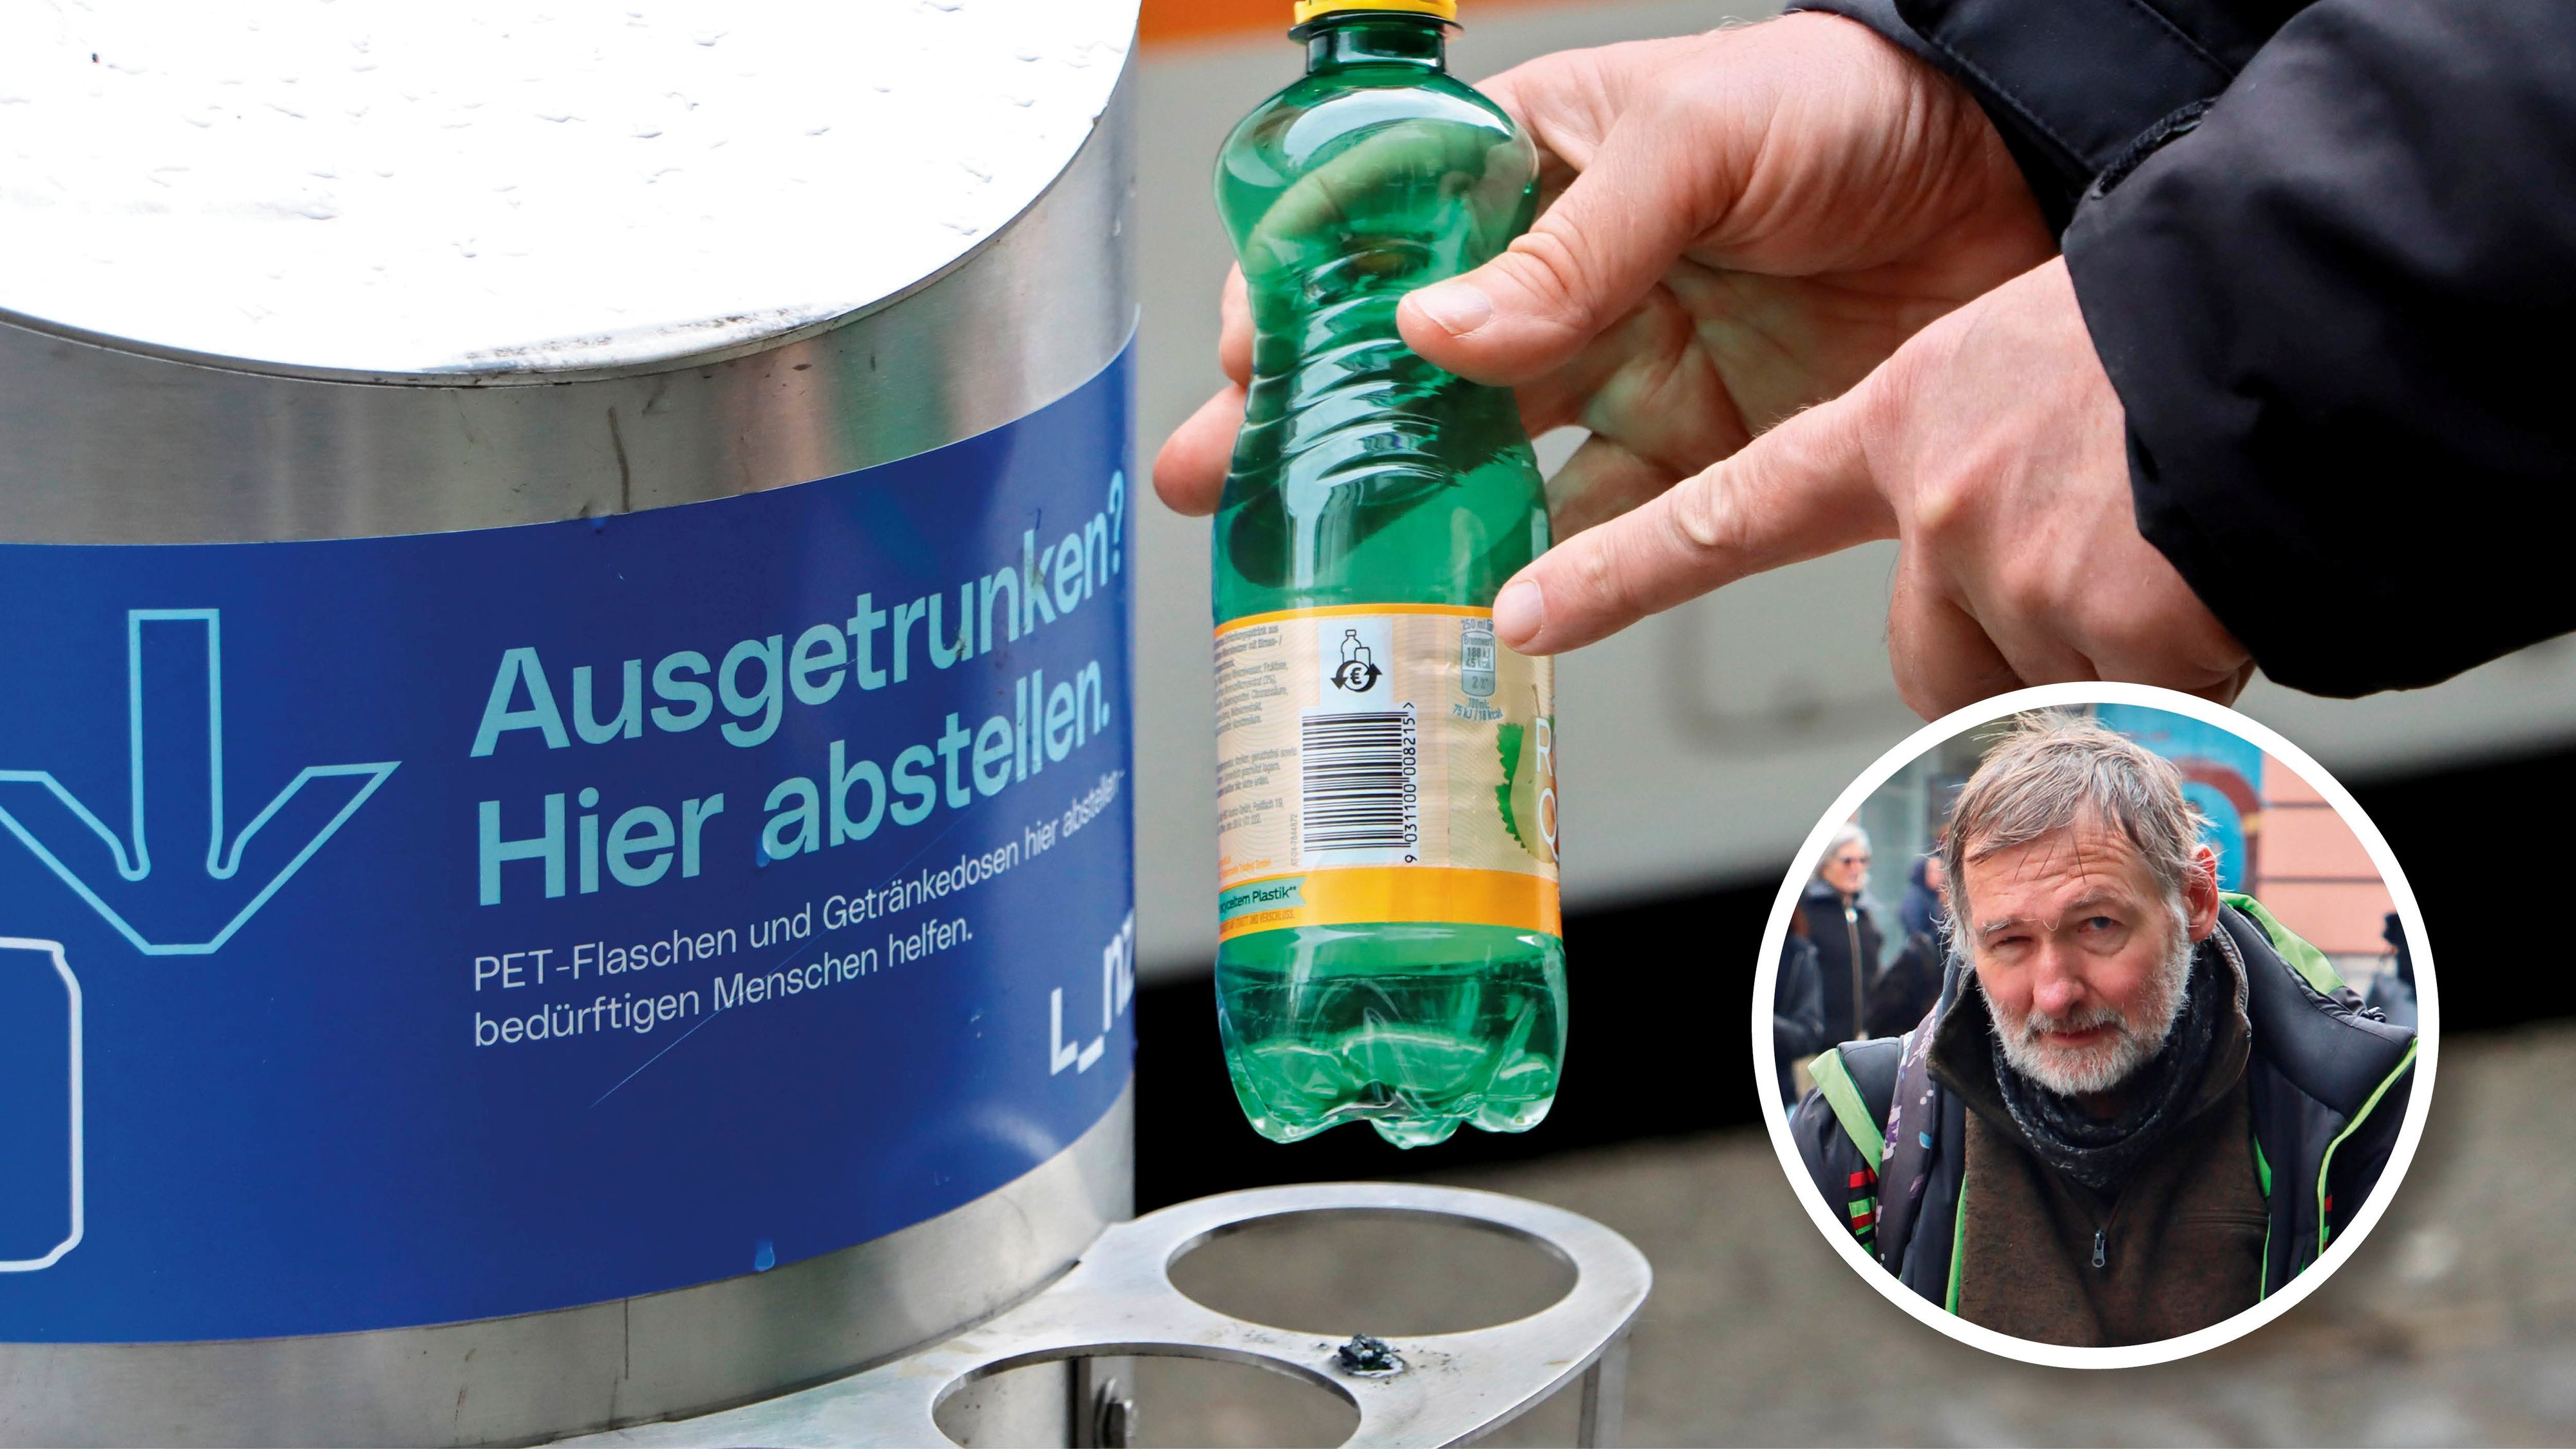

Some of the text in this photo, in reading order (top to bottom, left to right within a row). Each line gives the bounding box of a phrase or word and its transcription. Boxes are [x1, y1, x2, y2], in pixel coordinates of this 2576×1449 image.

[471, 470, 1124, 757] Ausgetrunken?
[479, 659, 1111, 906] Hier abstellen.
[475, 929, 736, 991] PET-Flaschen
[750, 902, 811, 949] und
[823, 840, 1019, 930] Getränkedosen
[1024, 818, 1059, 861] hier
[475, 918, 973, 1046] bedürftigen Menschen helfen.
